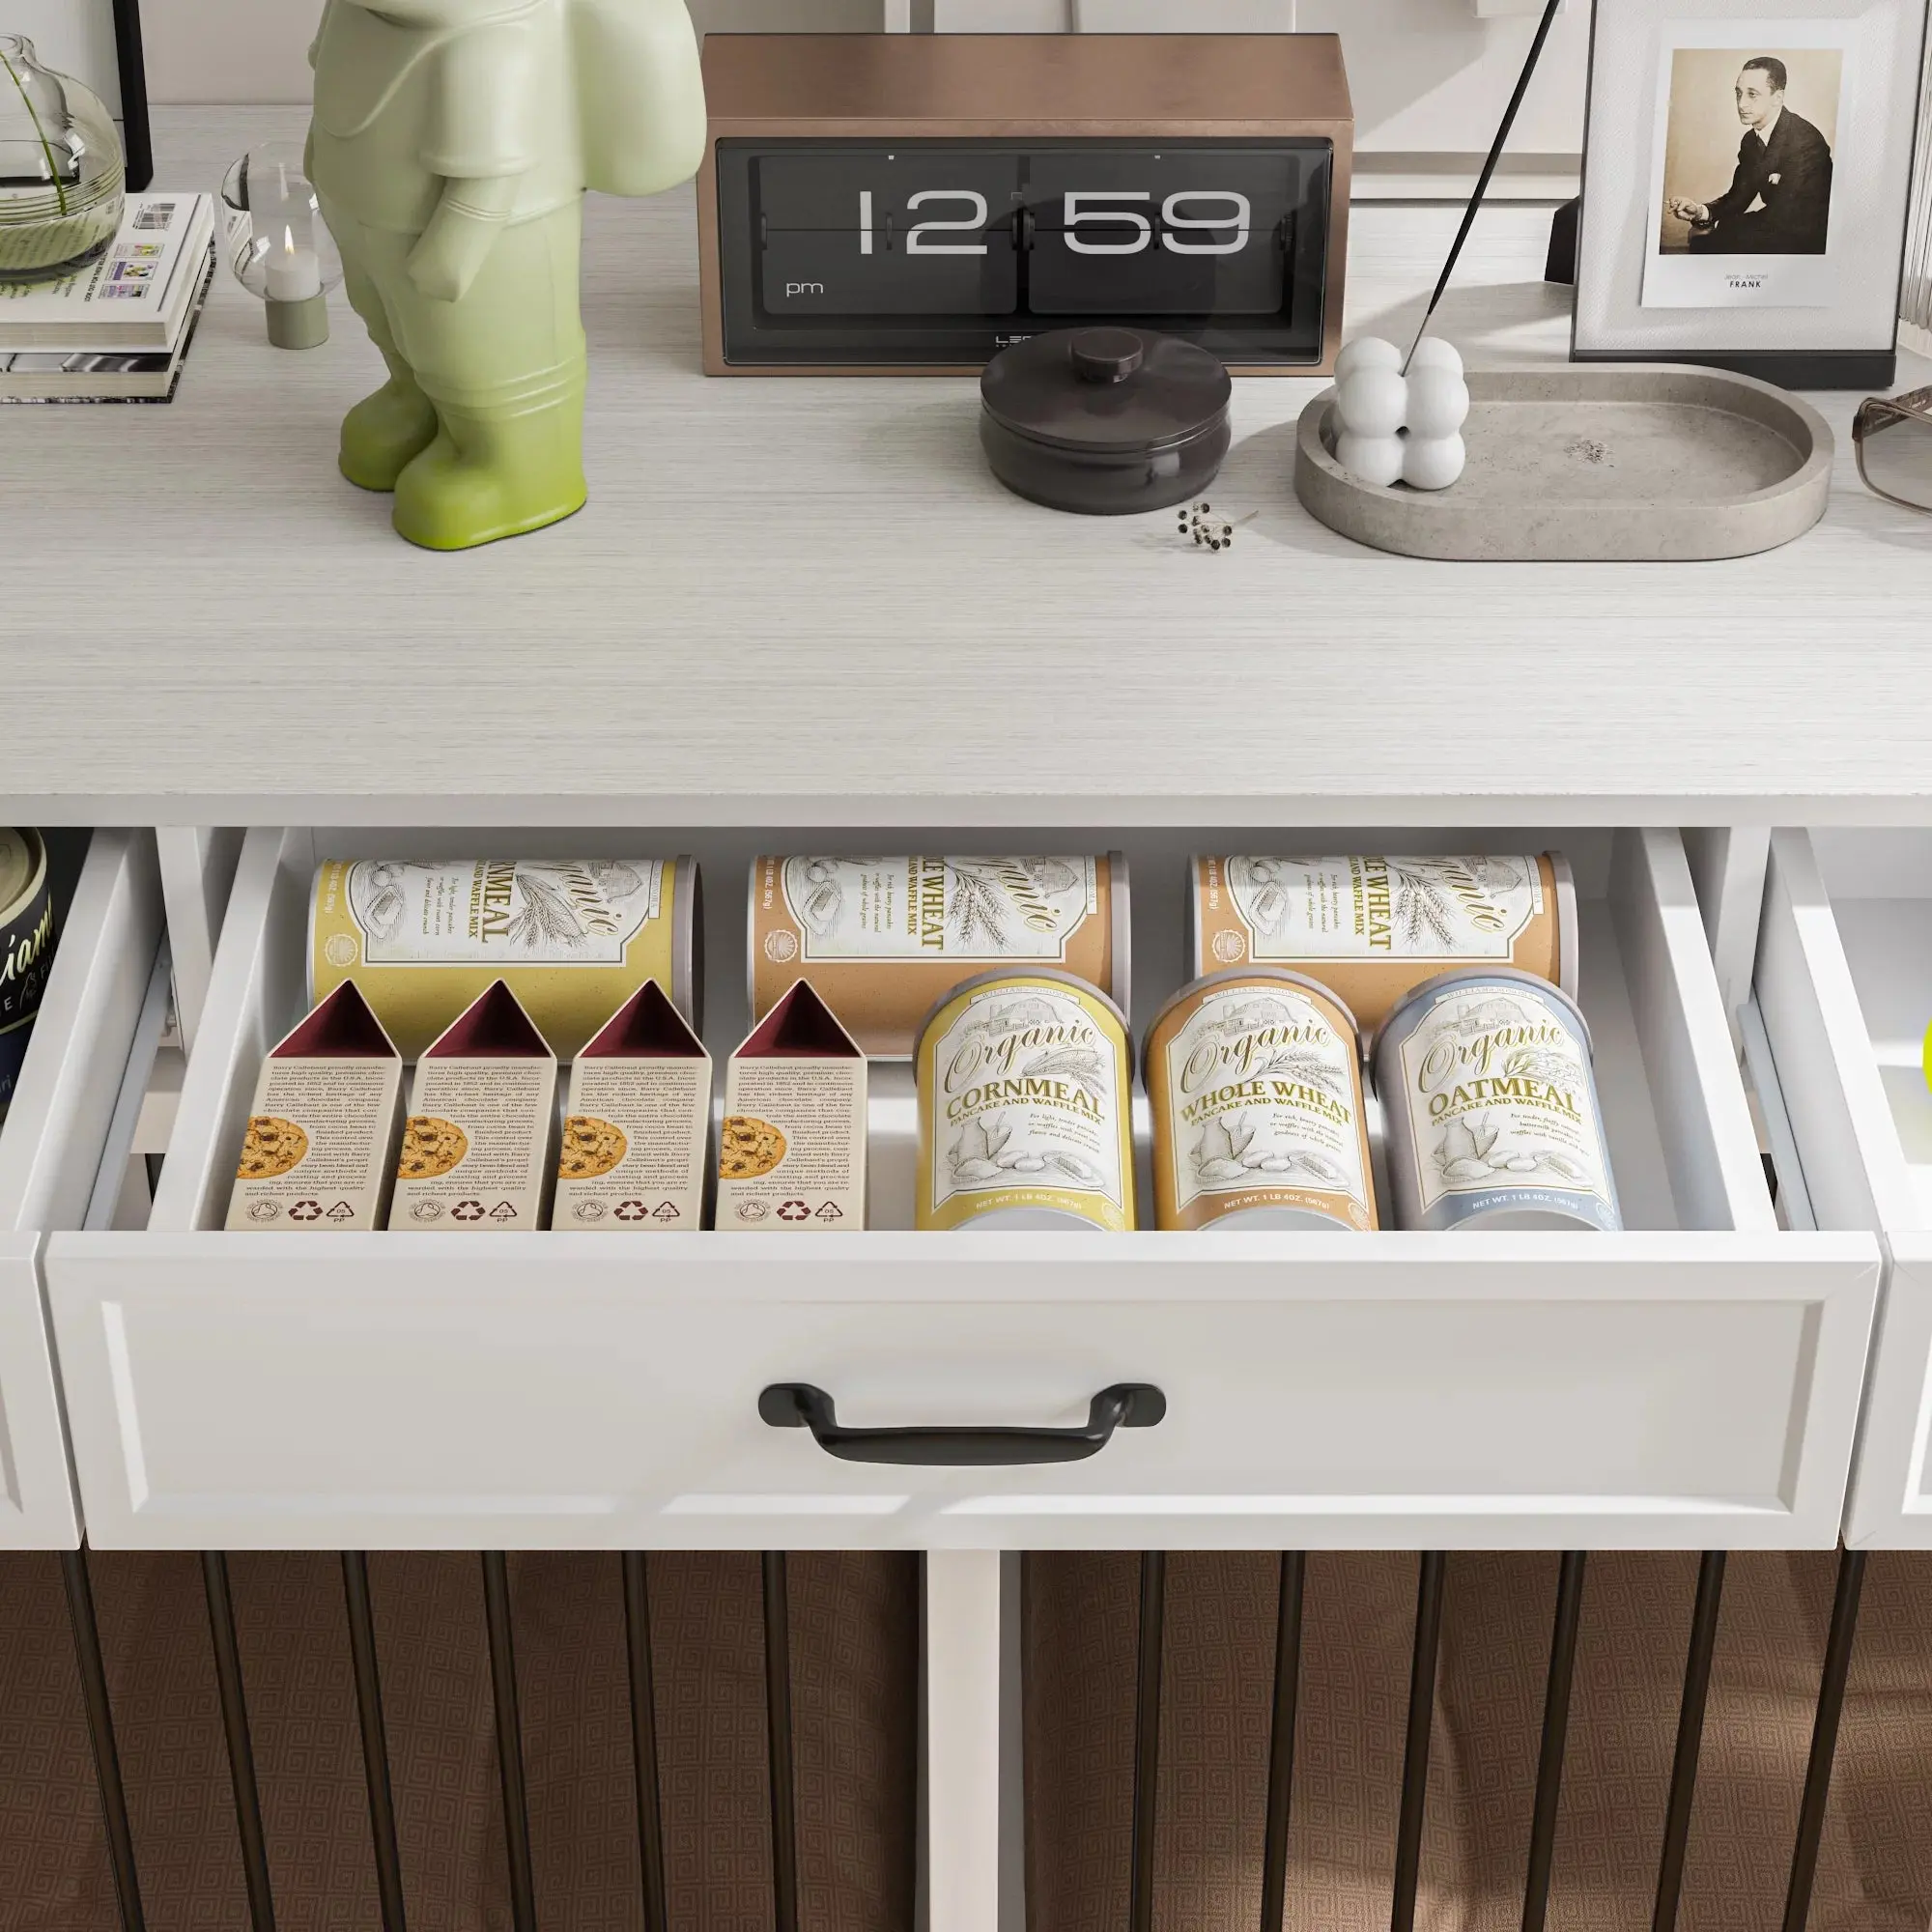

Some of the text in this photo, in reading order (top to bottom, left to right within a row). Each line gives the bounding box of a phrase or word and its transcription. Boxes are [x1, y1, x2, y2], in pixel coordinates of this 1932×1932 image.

[860, 190, 1251, 255] 12 59
[786, 282, 824, 298] pm
[470, 879, 483, 915] WAFFLE
[763, 890, 774, 909] (567g)
[908, 876, 918, 912] WAFFLE
[1209, 889, 1219, 910] (567g)
[1350, 860, 1365, 936] AND WAFFLE MIX
[469, 916, 479, 938] MIX
[908, 913, 918, 936] MIX
[921, 874, 945, 951] WHEAT
[1366, 874, 1392, 951] WHEAT
[945, 1019, 1096, 1094] Organic
[1180, 1019, 1330, 1094] Organic
[1418, 1019, 1565, 1094] Organic
[947, 1077, 1105, 1120] CORNMEAL
[951, 1096, 1103, 1127] PANCAKE AND WAFFLE MIX
[1180, 1080, 1351, 1125] WHOLE WHEAT
[1191, 1103, 1242, 1126] PANCAKE
[1273, 1097, 1321, 1115] WAFFLE
[1321, 1110, 1344, 1127] MIX
[1429, 1077, 1582, 1118] OATMEAL
[1432, 1103, 1483, 1126] PANCAKE
[1515, 1097, 1561, 1114] WAFFLE
[1560, 1108, 1583, 1125] MIX
[976, 1199, 993, 1210] NET
[1224, 1199, 1241, 1210] NET
[1243, 1194, 1261, 1204] WT.
[1472, 1199, 1491, 1210] NET
[1492, 1195, 1508, 1204] WT.
